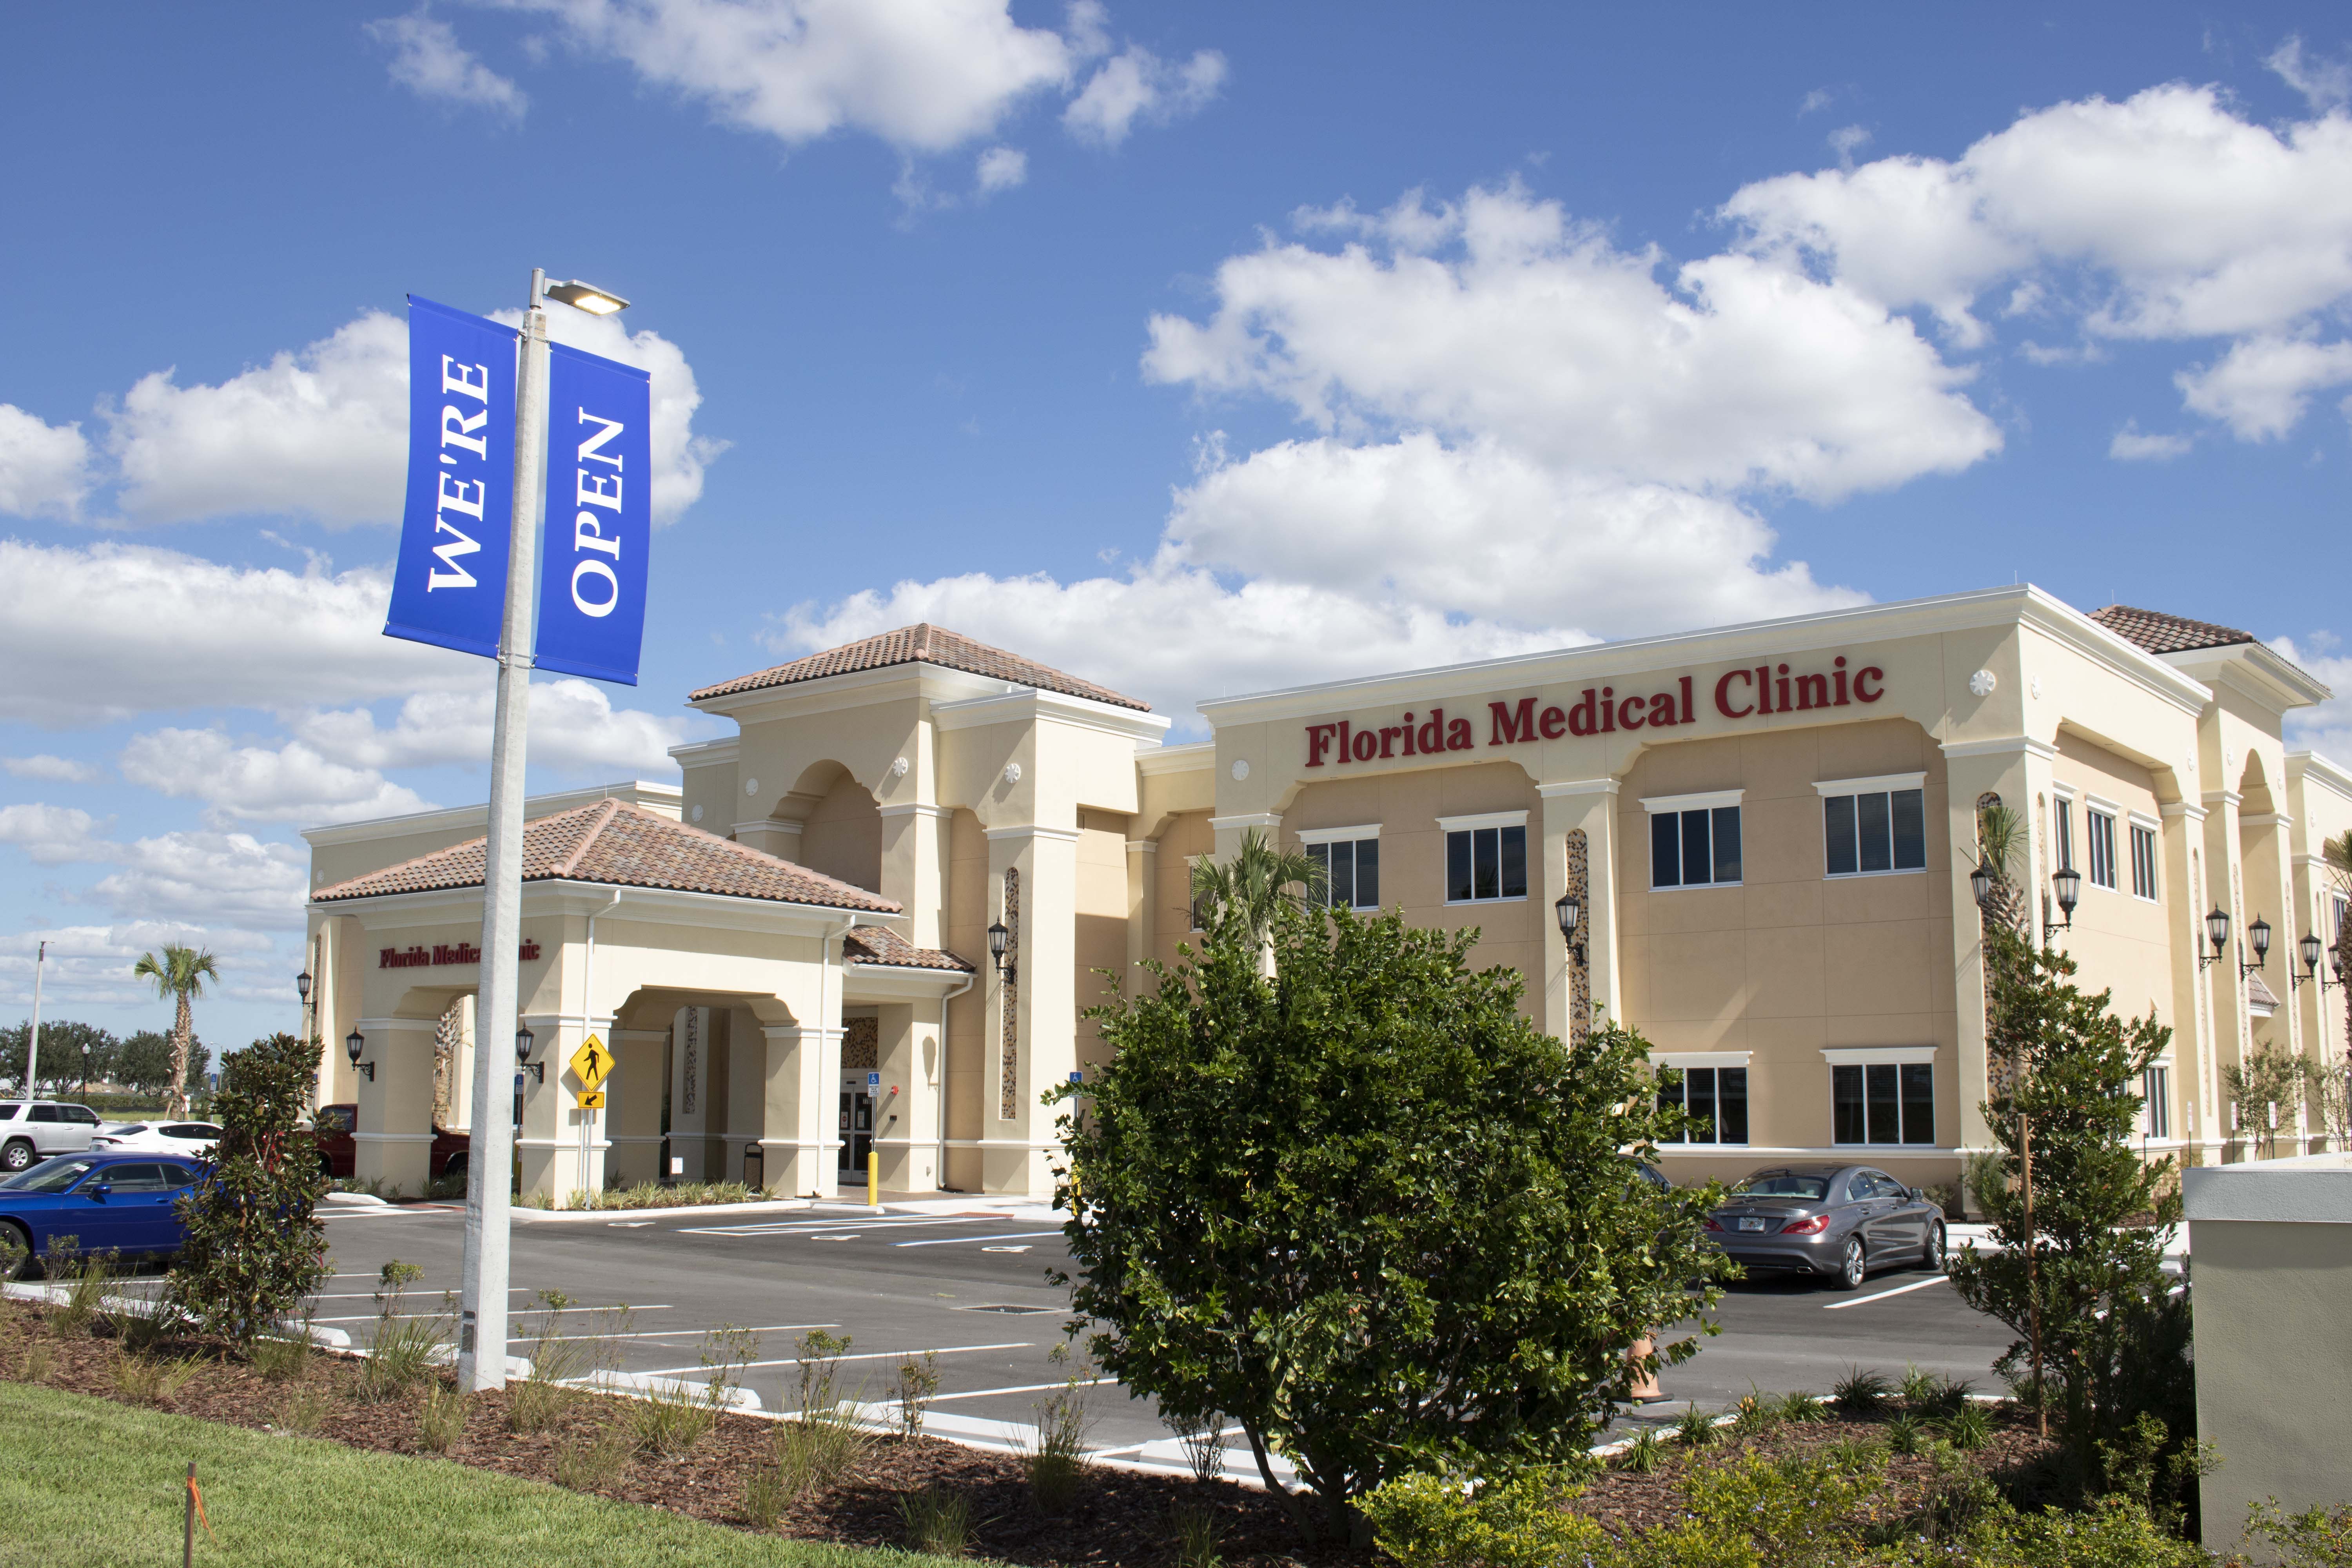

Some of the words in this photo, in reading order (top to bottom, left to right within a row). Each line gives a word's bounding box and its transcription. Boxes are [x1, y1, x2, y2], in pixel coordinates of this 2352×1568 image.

[427, 354, 488, 593] WE'RE
[572, 406, 624, 617] OPEN
[1306, 709, 1473, 766] Florida
[1488, 677, 1694, 745] Medical
[1716, 657, 1883, 718] Clinic
[379, 946, 430, 968] Florida
